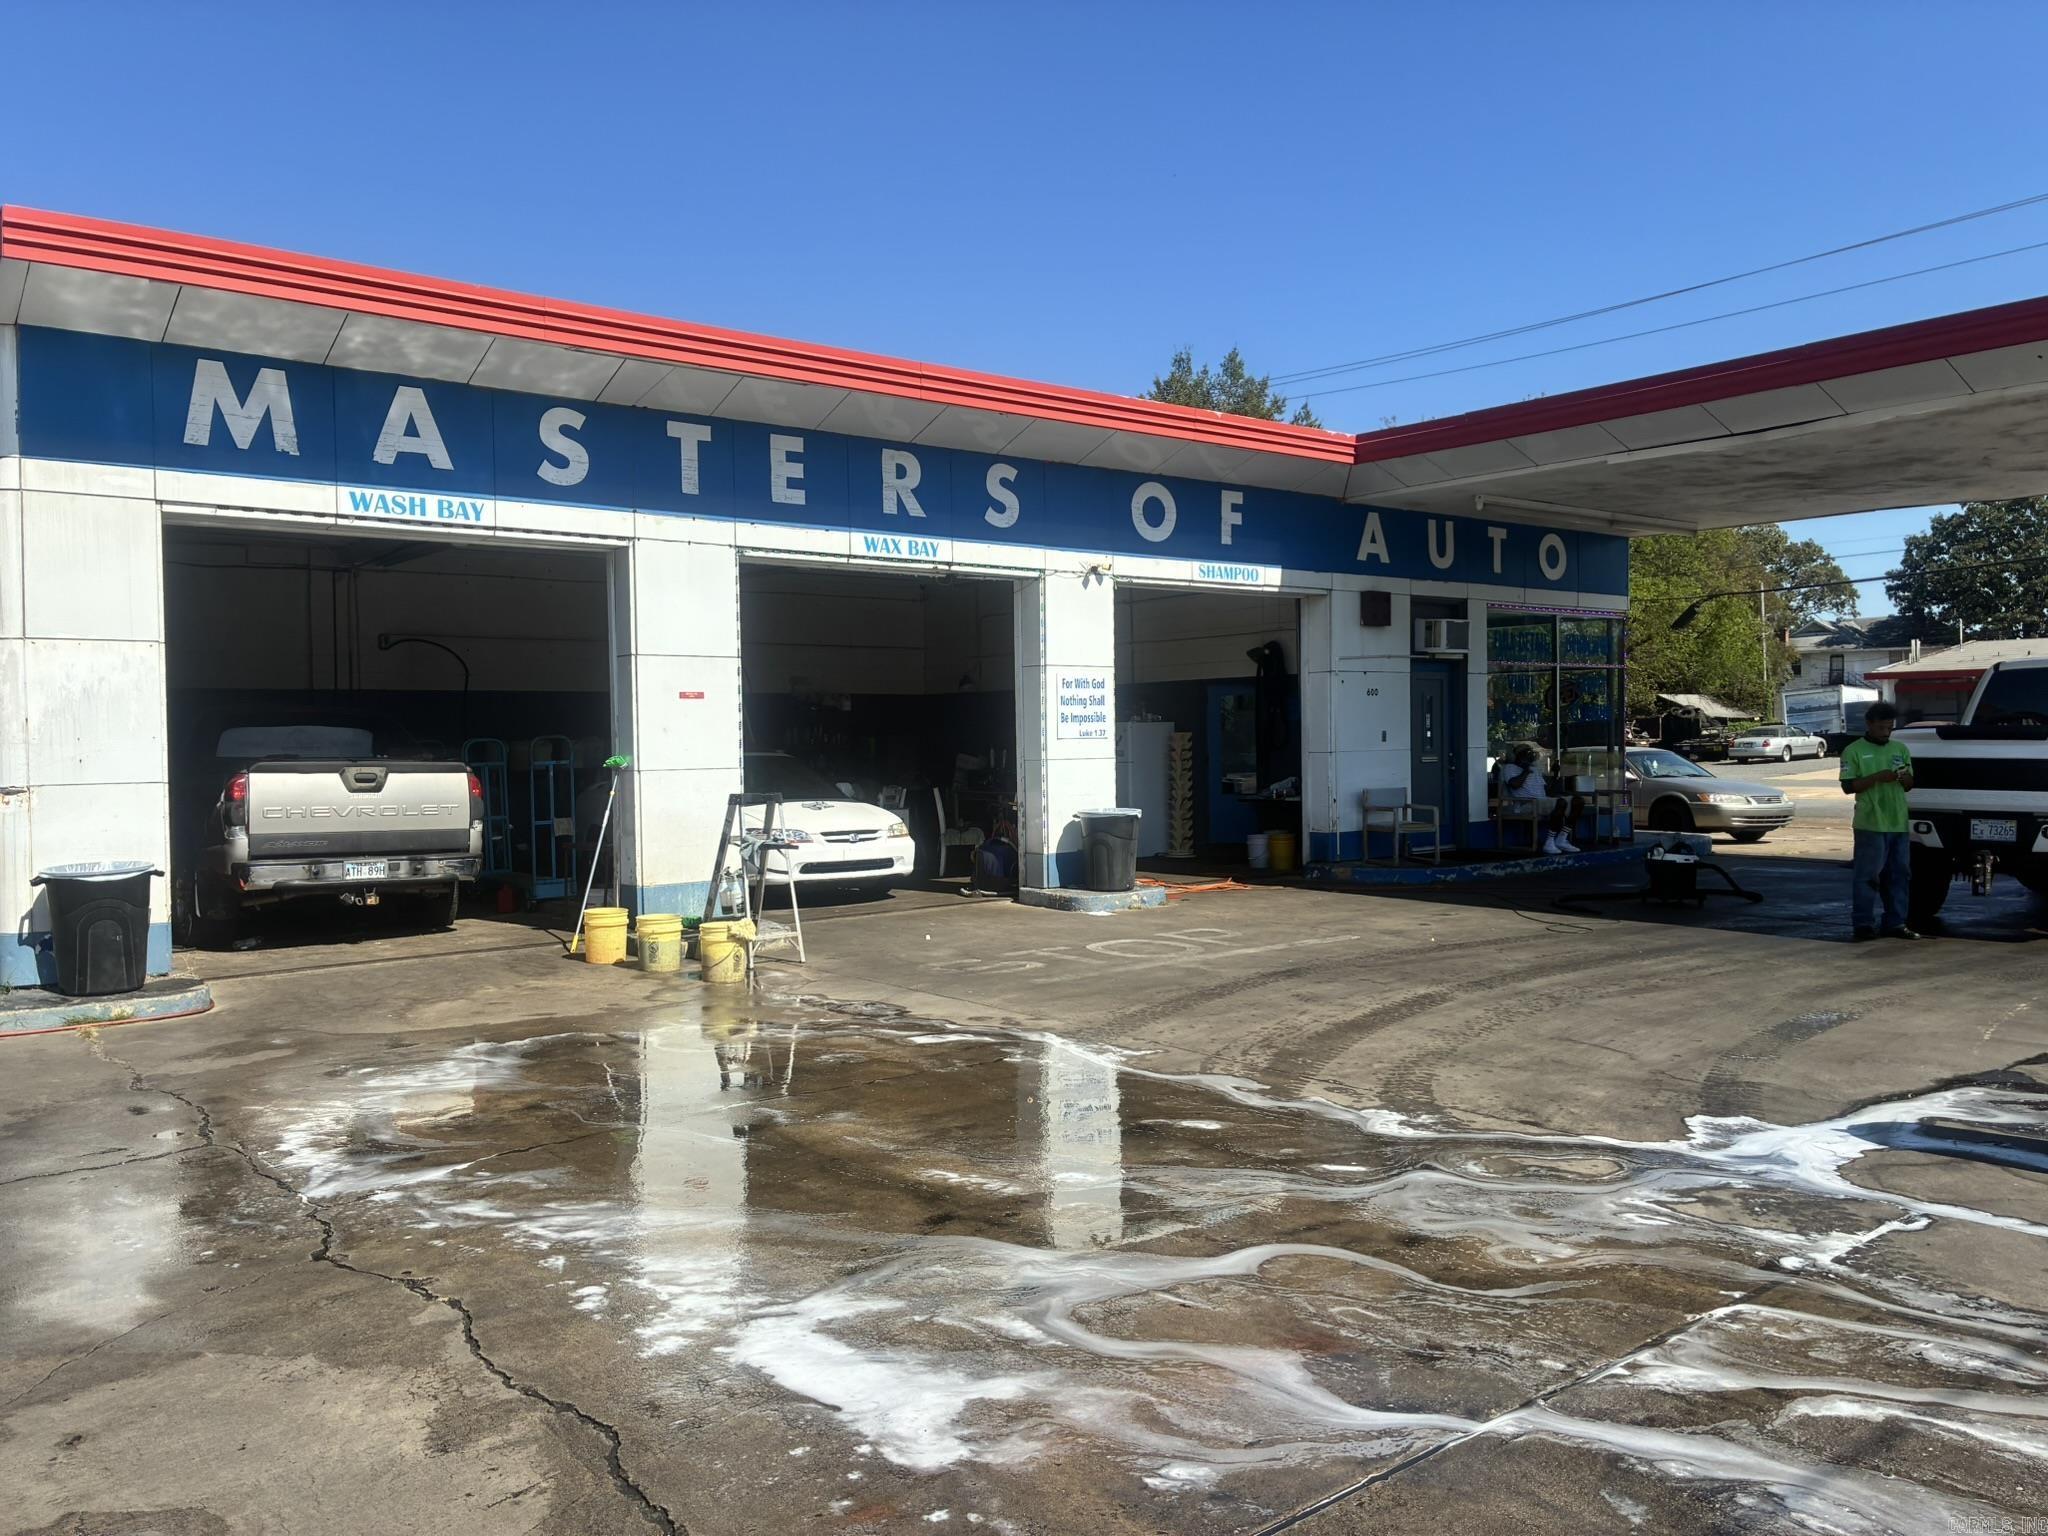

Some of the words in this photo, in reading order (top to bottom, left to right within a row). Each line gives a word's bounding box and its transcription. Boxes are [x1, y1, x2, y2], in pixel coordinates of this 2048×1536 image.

[183, 358, 1020, 528] MASTERS
[1131, 481, 1243, 545] OF
[1357, 511, 1567, 581] AUTO
[348, 490, 426, 517] WASH
[437, 498, 485, 522] BAY
[863, 535, 903, 556] WAX
[908, 540, 940, 558] BAY
[1197, 565, 1260, 582] SHAMPOO
[1062, 678, 1073, 689] For
[1075, 678, 1090, 689] With
[1091, 678, 1105, 689] God
[1061, 694, 1087, 709] Nothing
[1089, 694, 1105, 706] Shall
[1061, 713, 1069, 723] Be
[1071, 712, 1106, 726] Impossible
[261, 803, 460, 819] CHEVROLET
